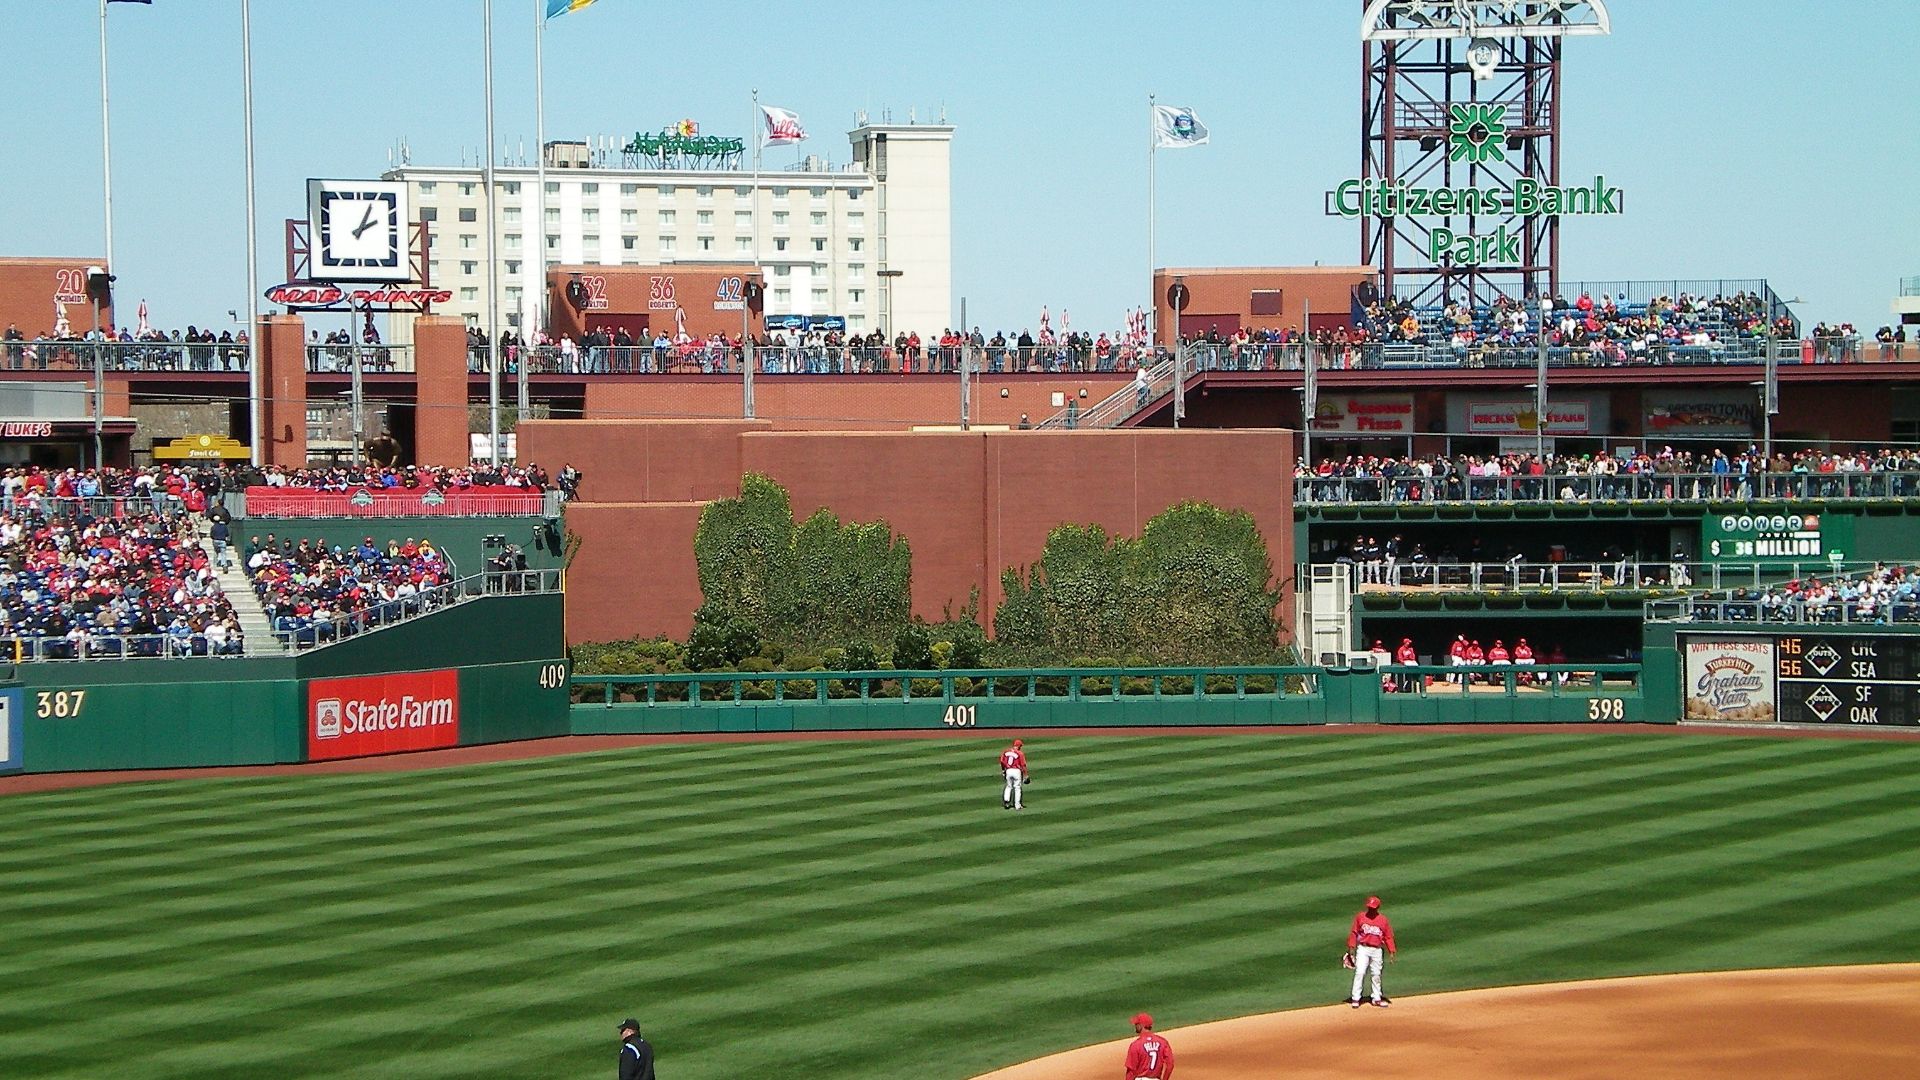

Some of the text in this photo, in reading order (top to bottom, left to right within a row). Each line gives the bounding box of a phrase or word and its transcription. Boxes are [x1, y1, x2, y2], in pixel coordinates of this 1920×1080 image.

[1334, 175, 1620, 217] Citizens Bank
[1430, 225, 1520, 264] Park
[56, 269, 85, 294] 20
[581, 276, 607, 300] 32
[650, 276, 675, 300] 36
[717, 278, 742, 301] 42
[649, 300, 677, 309] ROBERTS
[5, 422, 51, 436] LUKE'S
[1721, 515, 1803, 532] POWER
[1711, 540, 1821, 556] $ 36 MILLION
[1691, 643, 1709, 653] WIN
[1780, 639, 1802, 654] 46
[1850, 641, 1878, 657] CHC
[540, 664, 565, 689] 409
[1780, 659, 1802, 675] 56
[1850, 661, 1877, 678] SEA
[1696, 672, 1764, 698] Graham
[1855, 685, 1872, 702] SF
[37, 690, 85, 718] 387
[1589, 698, 1624, 720] 398
[1709, 688, 1751, 712] Slam
[943, 705, 976, 726] 401
[1849, 706, 1879, 723] OAK
[1149, 1051, 1158, 1070] 7
